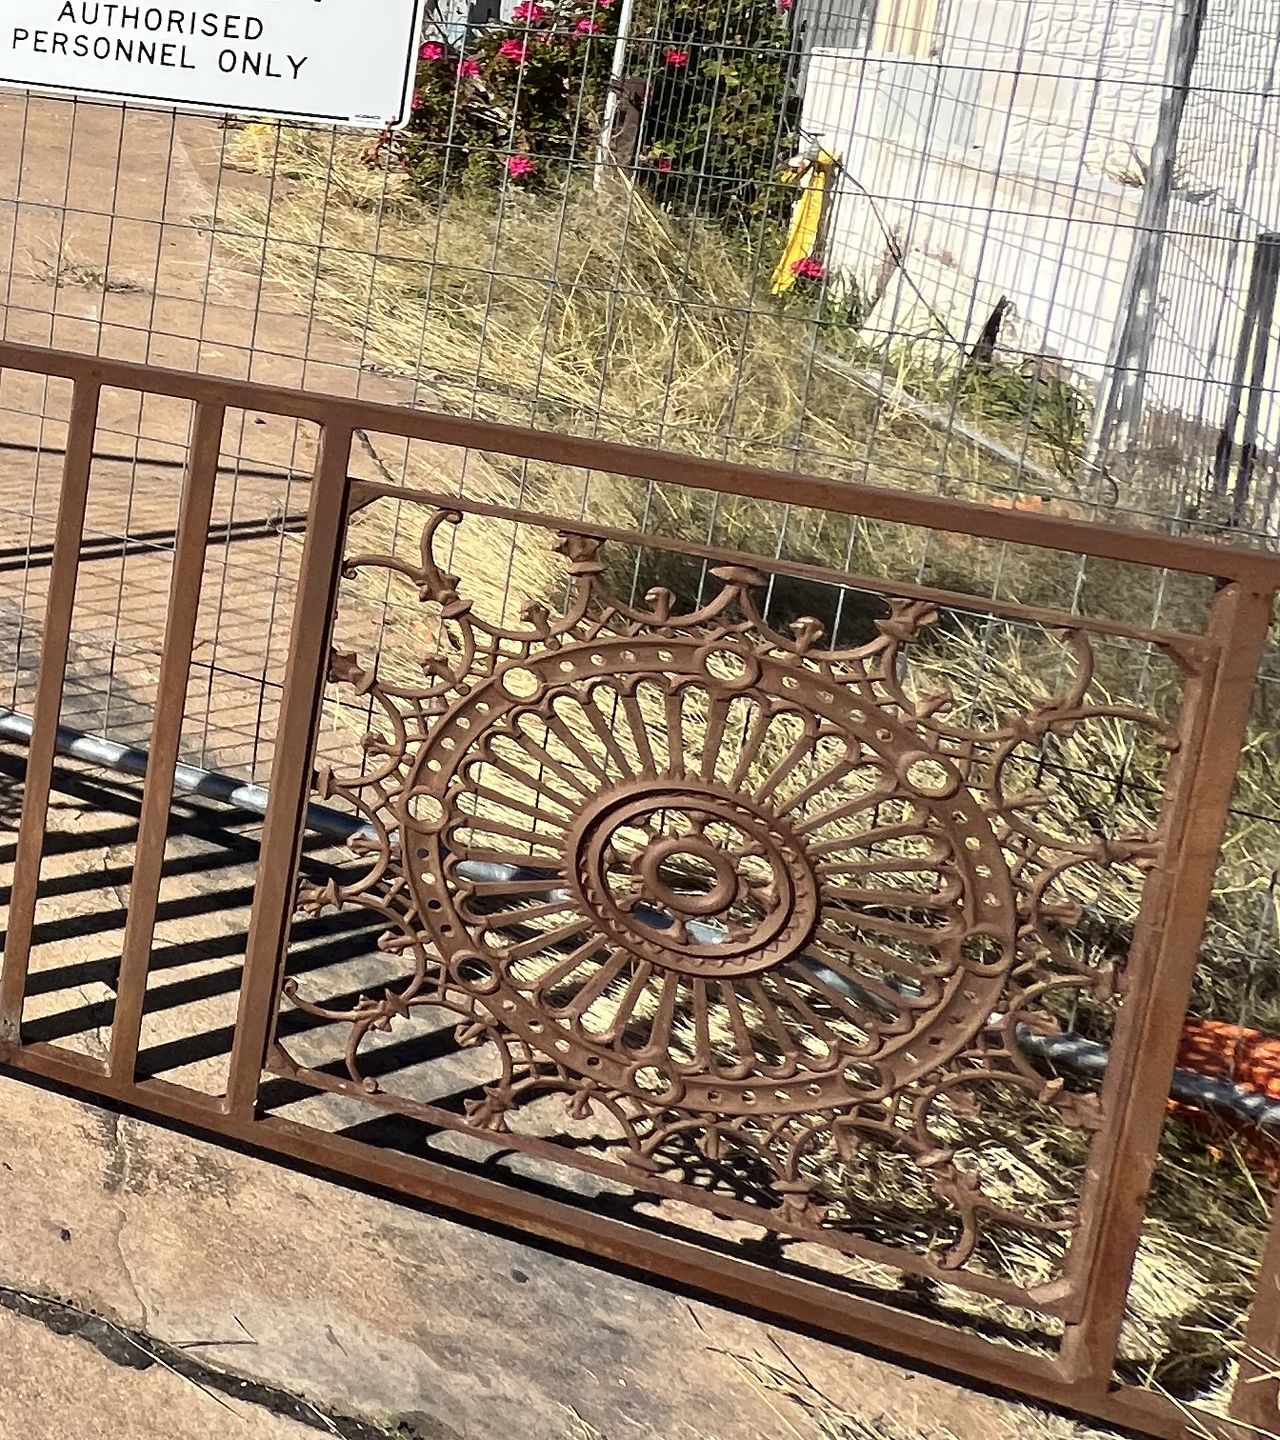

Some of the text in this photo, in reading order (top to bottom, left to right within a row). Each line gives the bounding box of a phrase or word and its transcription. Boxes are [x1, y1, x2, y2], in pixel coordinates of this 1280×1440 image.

[57, 1, 264, 40] AUTHORISED
[12, 28, 308, 79] PERSONNEL ONLY
